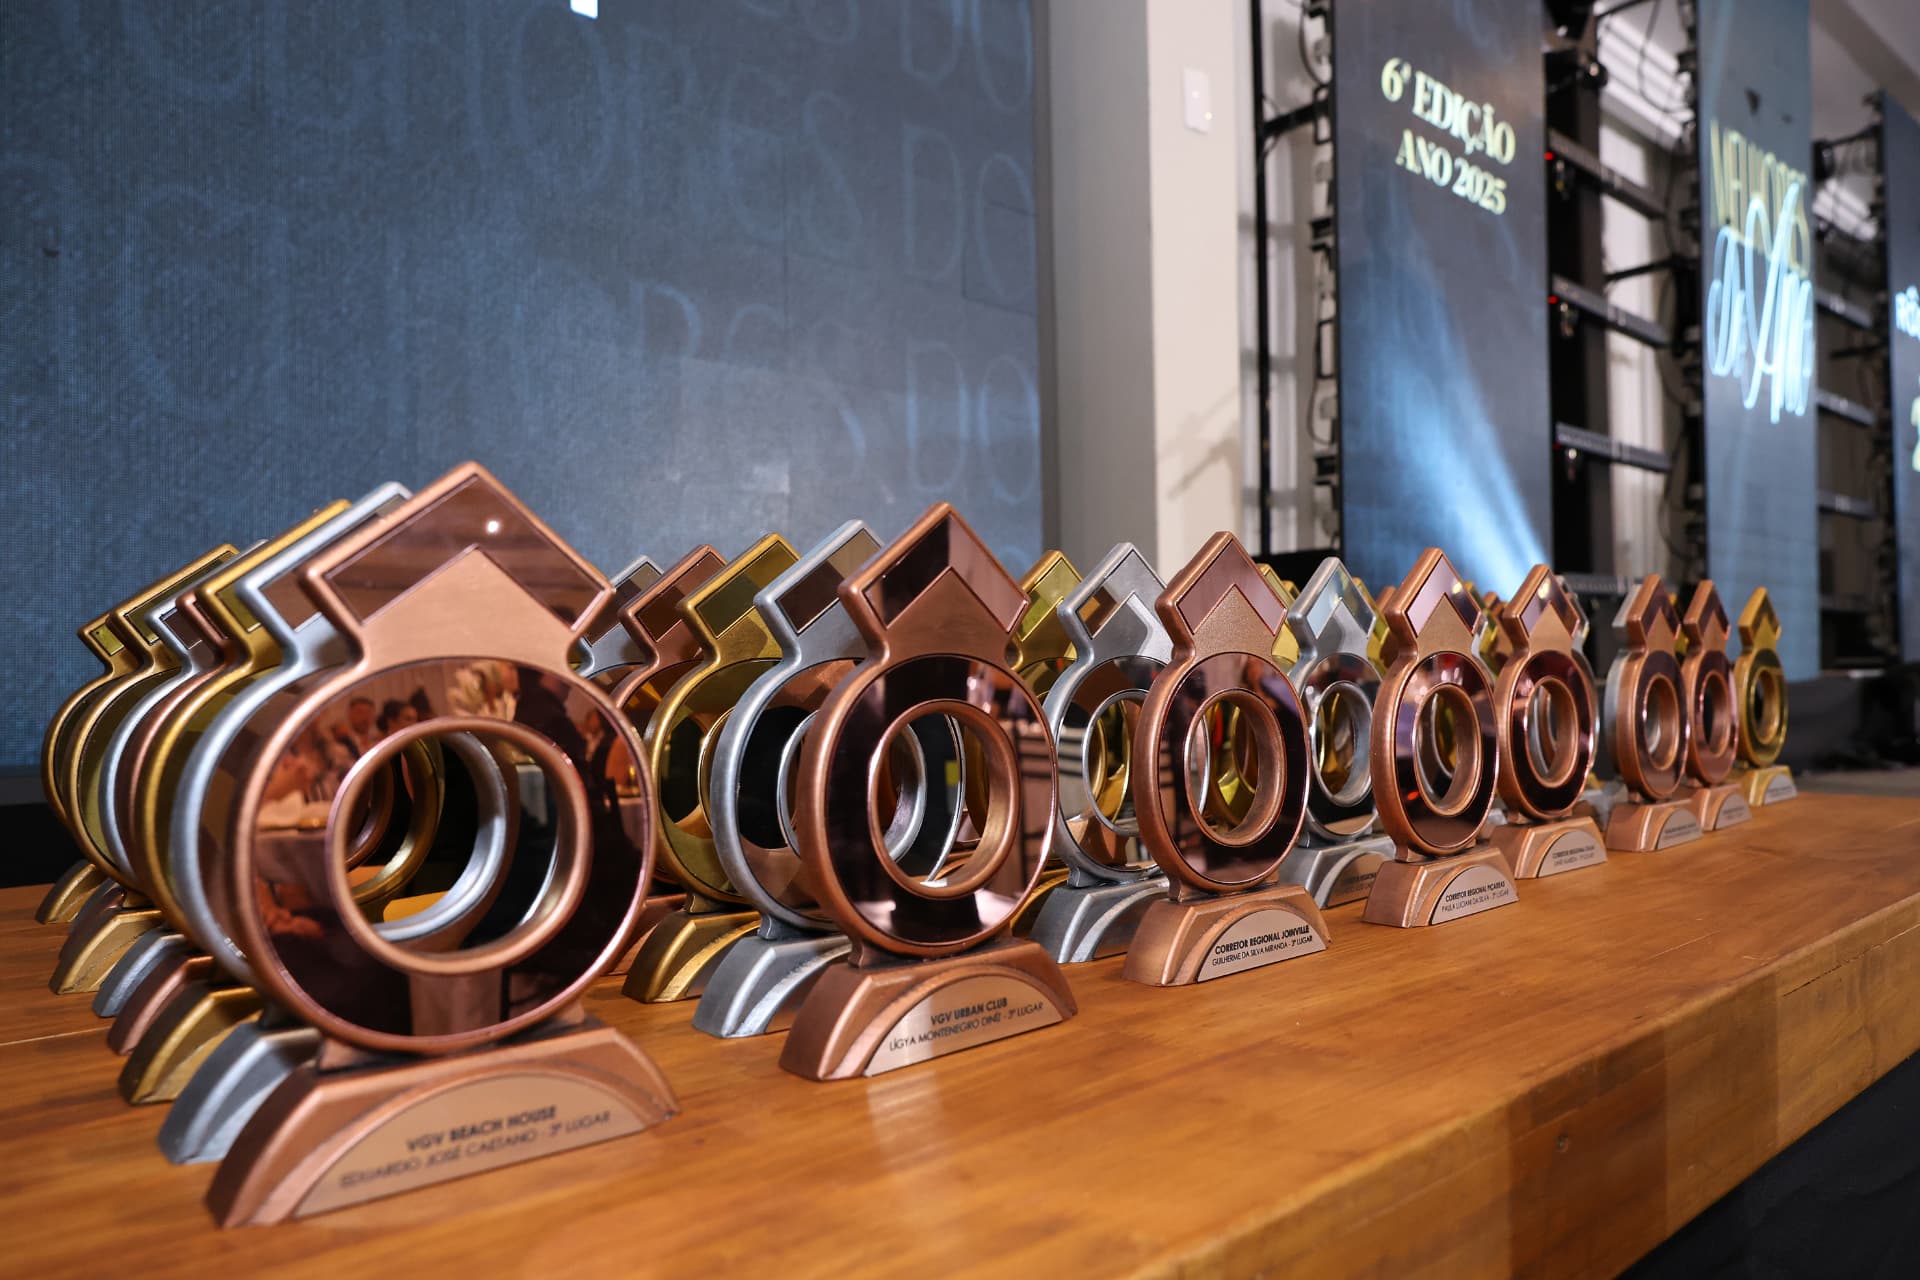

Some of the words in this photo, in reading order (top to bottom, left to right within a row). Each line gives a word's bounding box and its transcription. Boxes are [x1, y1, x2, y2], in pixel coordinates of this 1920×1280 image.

[1412, 70, 1516, 165] EDIÇÃO
[1395, 129, 1452, 187] ANO
[1452, 156, 1507, 215] 2025
[1212, 952, 1241, 966] GUILHERME
[1242, 950, 1250, 959] DA
[1250, 946, 1265, 957] SILVA
[1265, 942, 1288, 953] MIRANDA
[1296, 935, 1313, 946] LUGAR
[1214, 939, 1249, 955] CORRETOR
[1249, 932, 1280, 946] REGIONAL
[1281, 925, 1309, 939] JOINVILLE
[918, 1018, 980, 1044] MONTENEGRO
[1016, 1002, 1044, 1017] LUGAR
[930, 1012, 951, 1025] VGV
[954, 1004, 984, 1020] URBAN
[986, 997, 1008, 1012] CLUB
[339, 1156, 422, 1189] EDUARDO
[466, 1128, 538, 1157] CAETANO
[565, 1110, 611, 1134] LUGAR
[405, 1132, 445, 1153] VGV
[449, 1115, 503, 1142] BEACH
[507, 1105, 557, 1128] HOUSE
